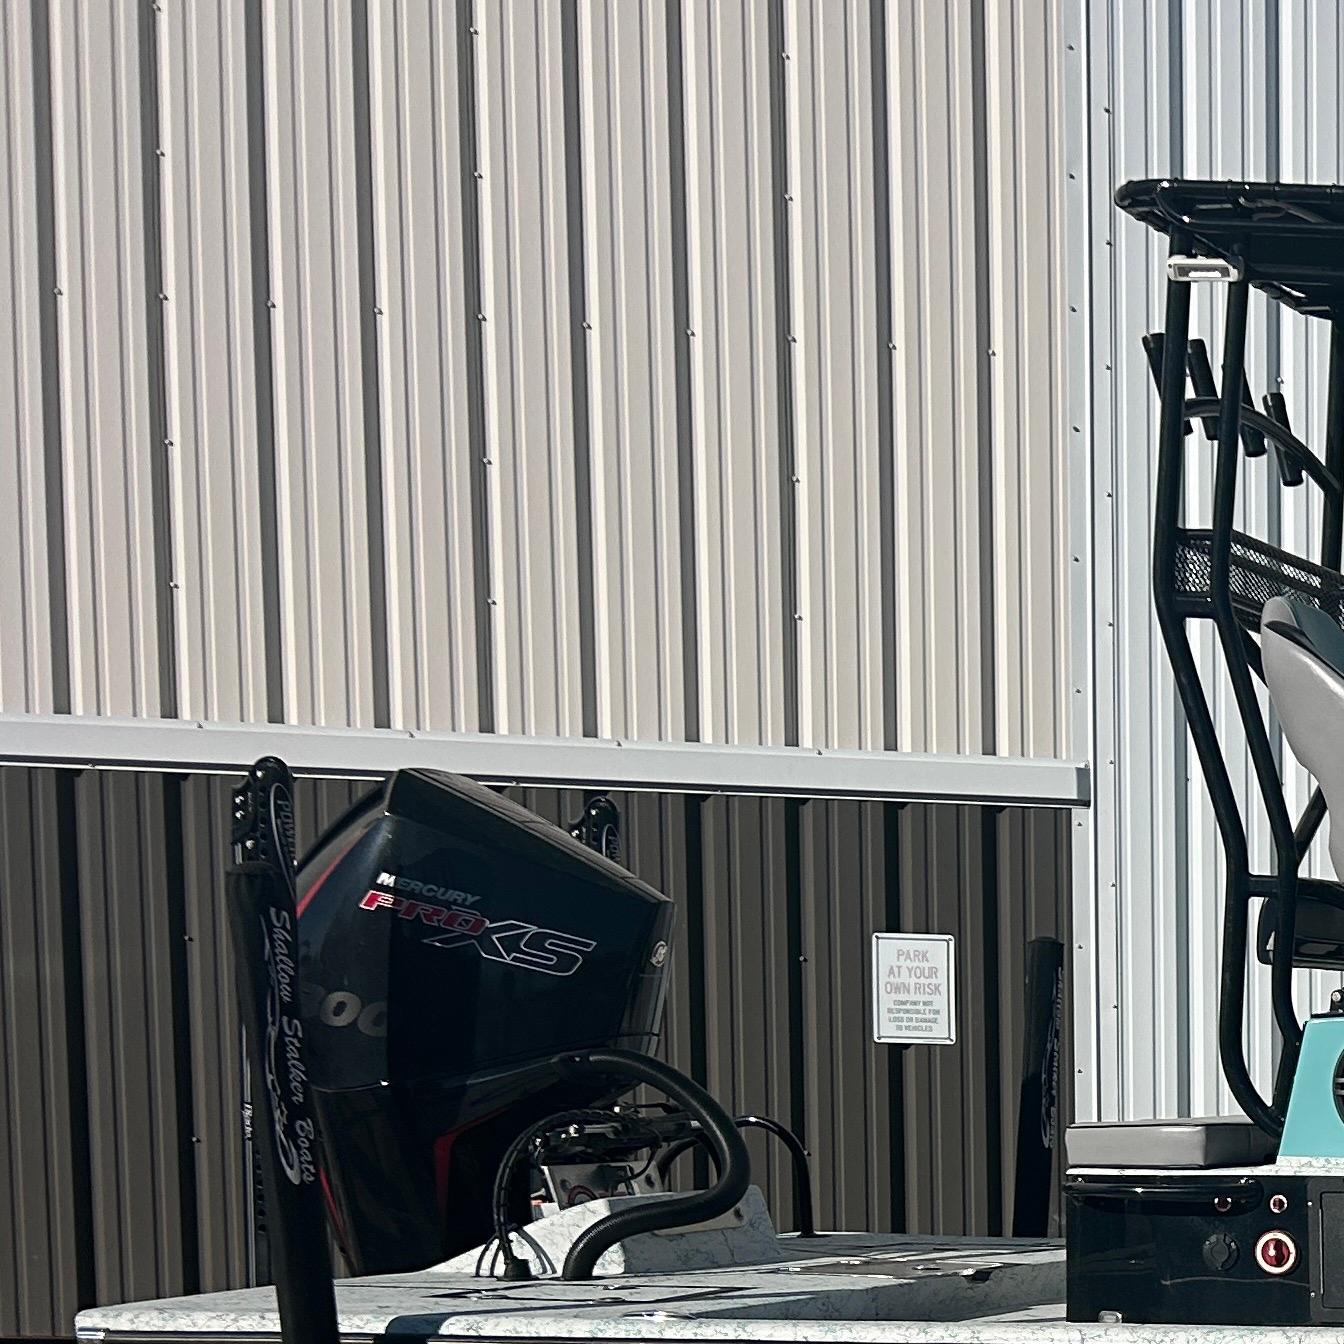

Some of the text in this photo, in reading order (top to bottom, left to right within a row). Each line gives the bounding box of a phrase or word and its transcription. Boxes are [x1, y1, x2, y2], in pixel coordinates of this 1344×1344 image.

[376, 872, 482, 905] MERCURY
[359, 889, 598, 976] PRO XS
[896, 948, 930, 963] PARK
[887, 965, 939, 980] AT YOUR
[884, 981, 942, 996] OWN RISK
